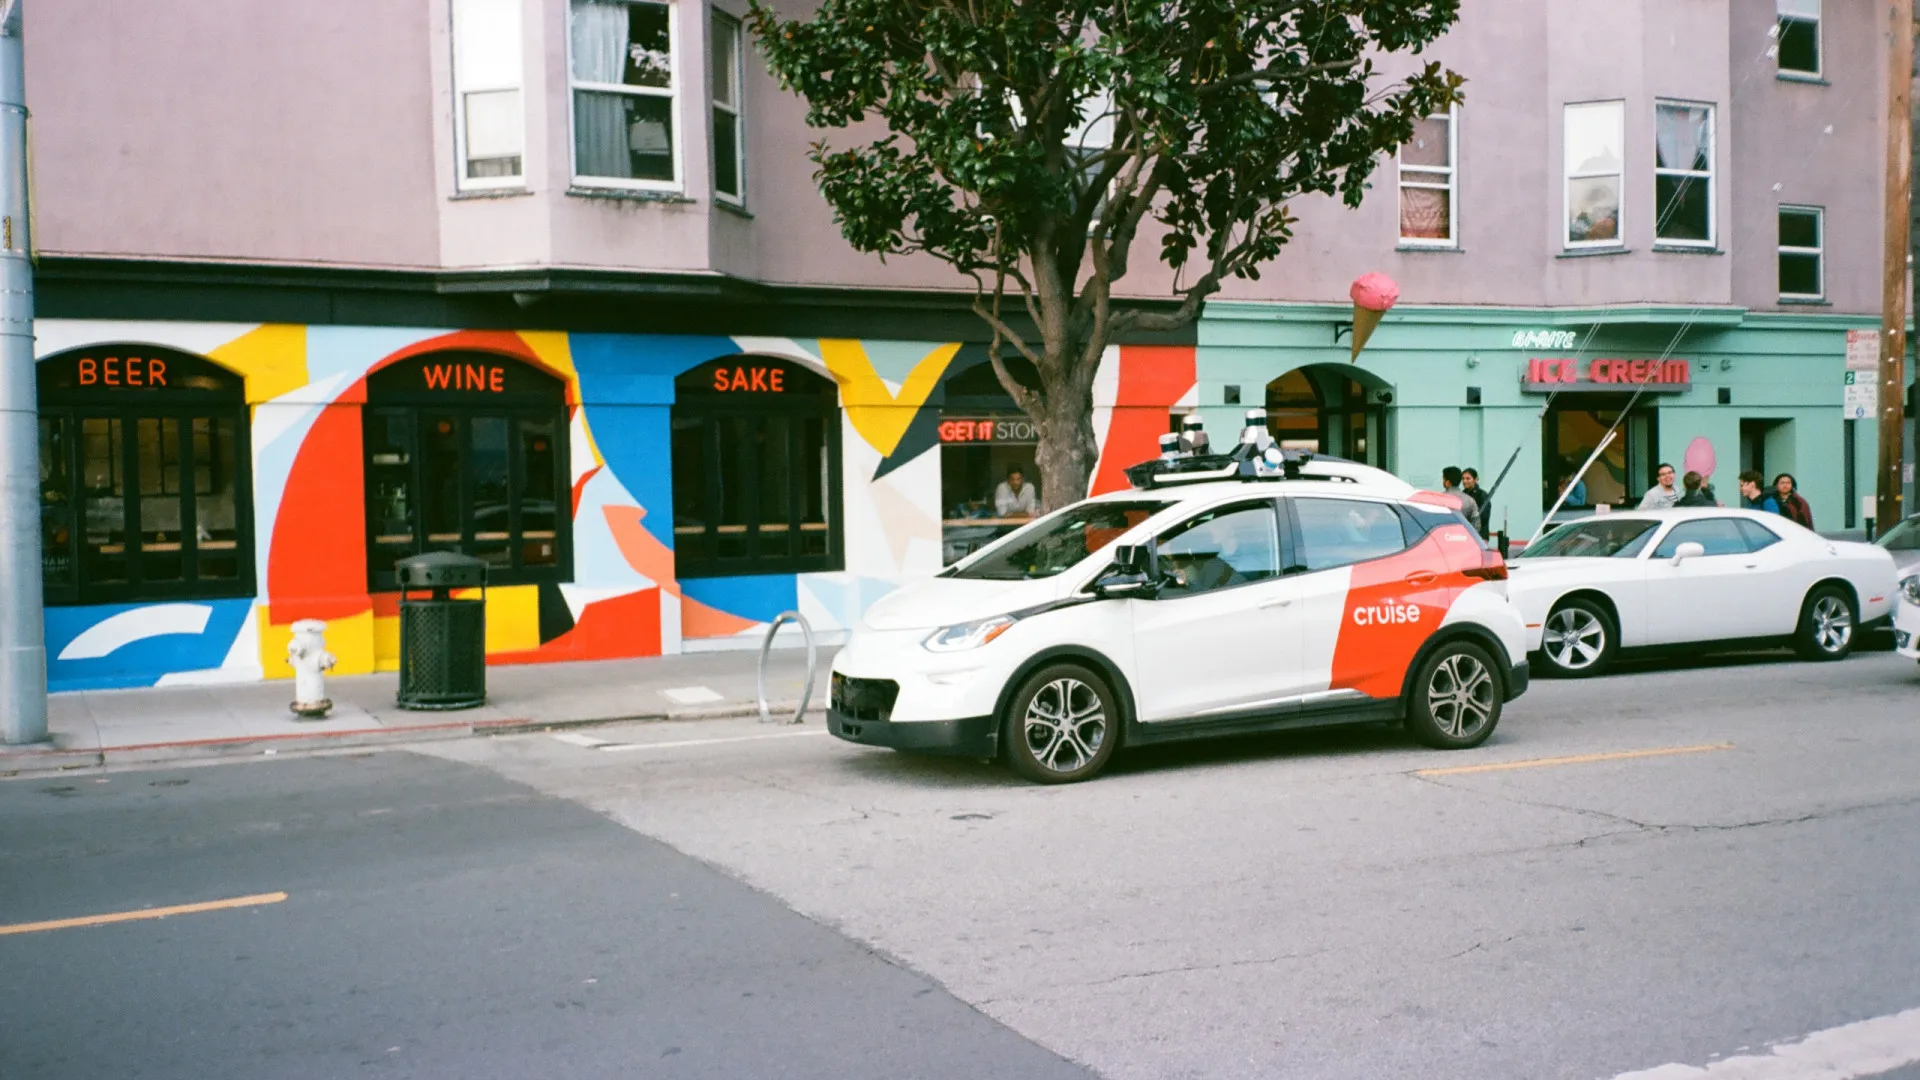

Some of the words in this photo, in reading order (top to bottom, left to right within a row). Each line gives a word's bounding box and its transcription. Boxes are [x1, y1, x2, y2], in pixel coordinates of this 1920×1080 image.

[79, 357, 166, 386] BEER
[423, 363, 504, 392] WINE
[714, 366, 784, 392] SAKE
[1528, 358, 1577, 383] ICE
[1589, 358, 1689, 383] CREAM
[1845, 372, 1854, 385] 2
[940, 420, 976, 441] GET
[978, 421, 993, 441] IT
[1353, 599, 1420, 626] cruise
